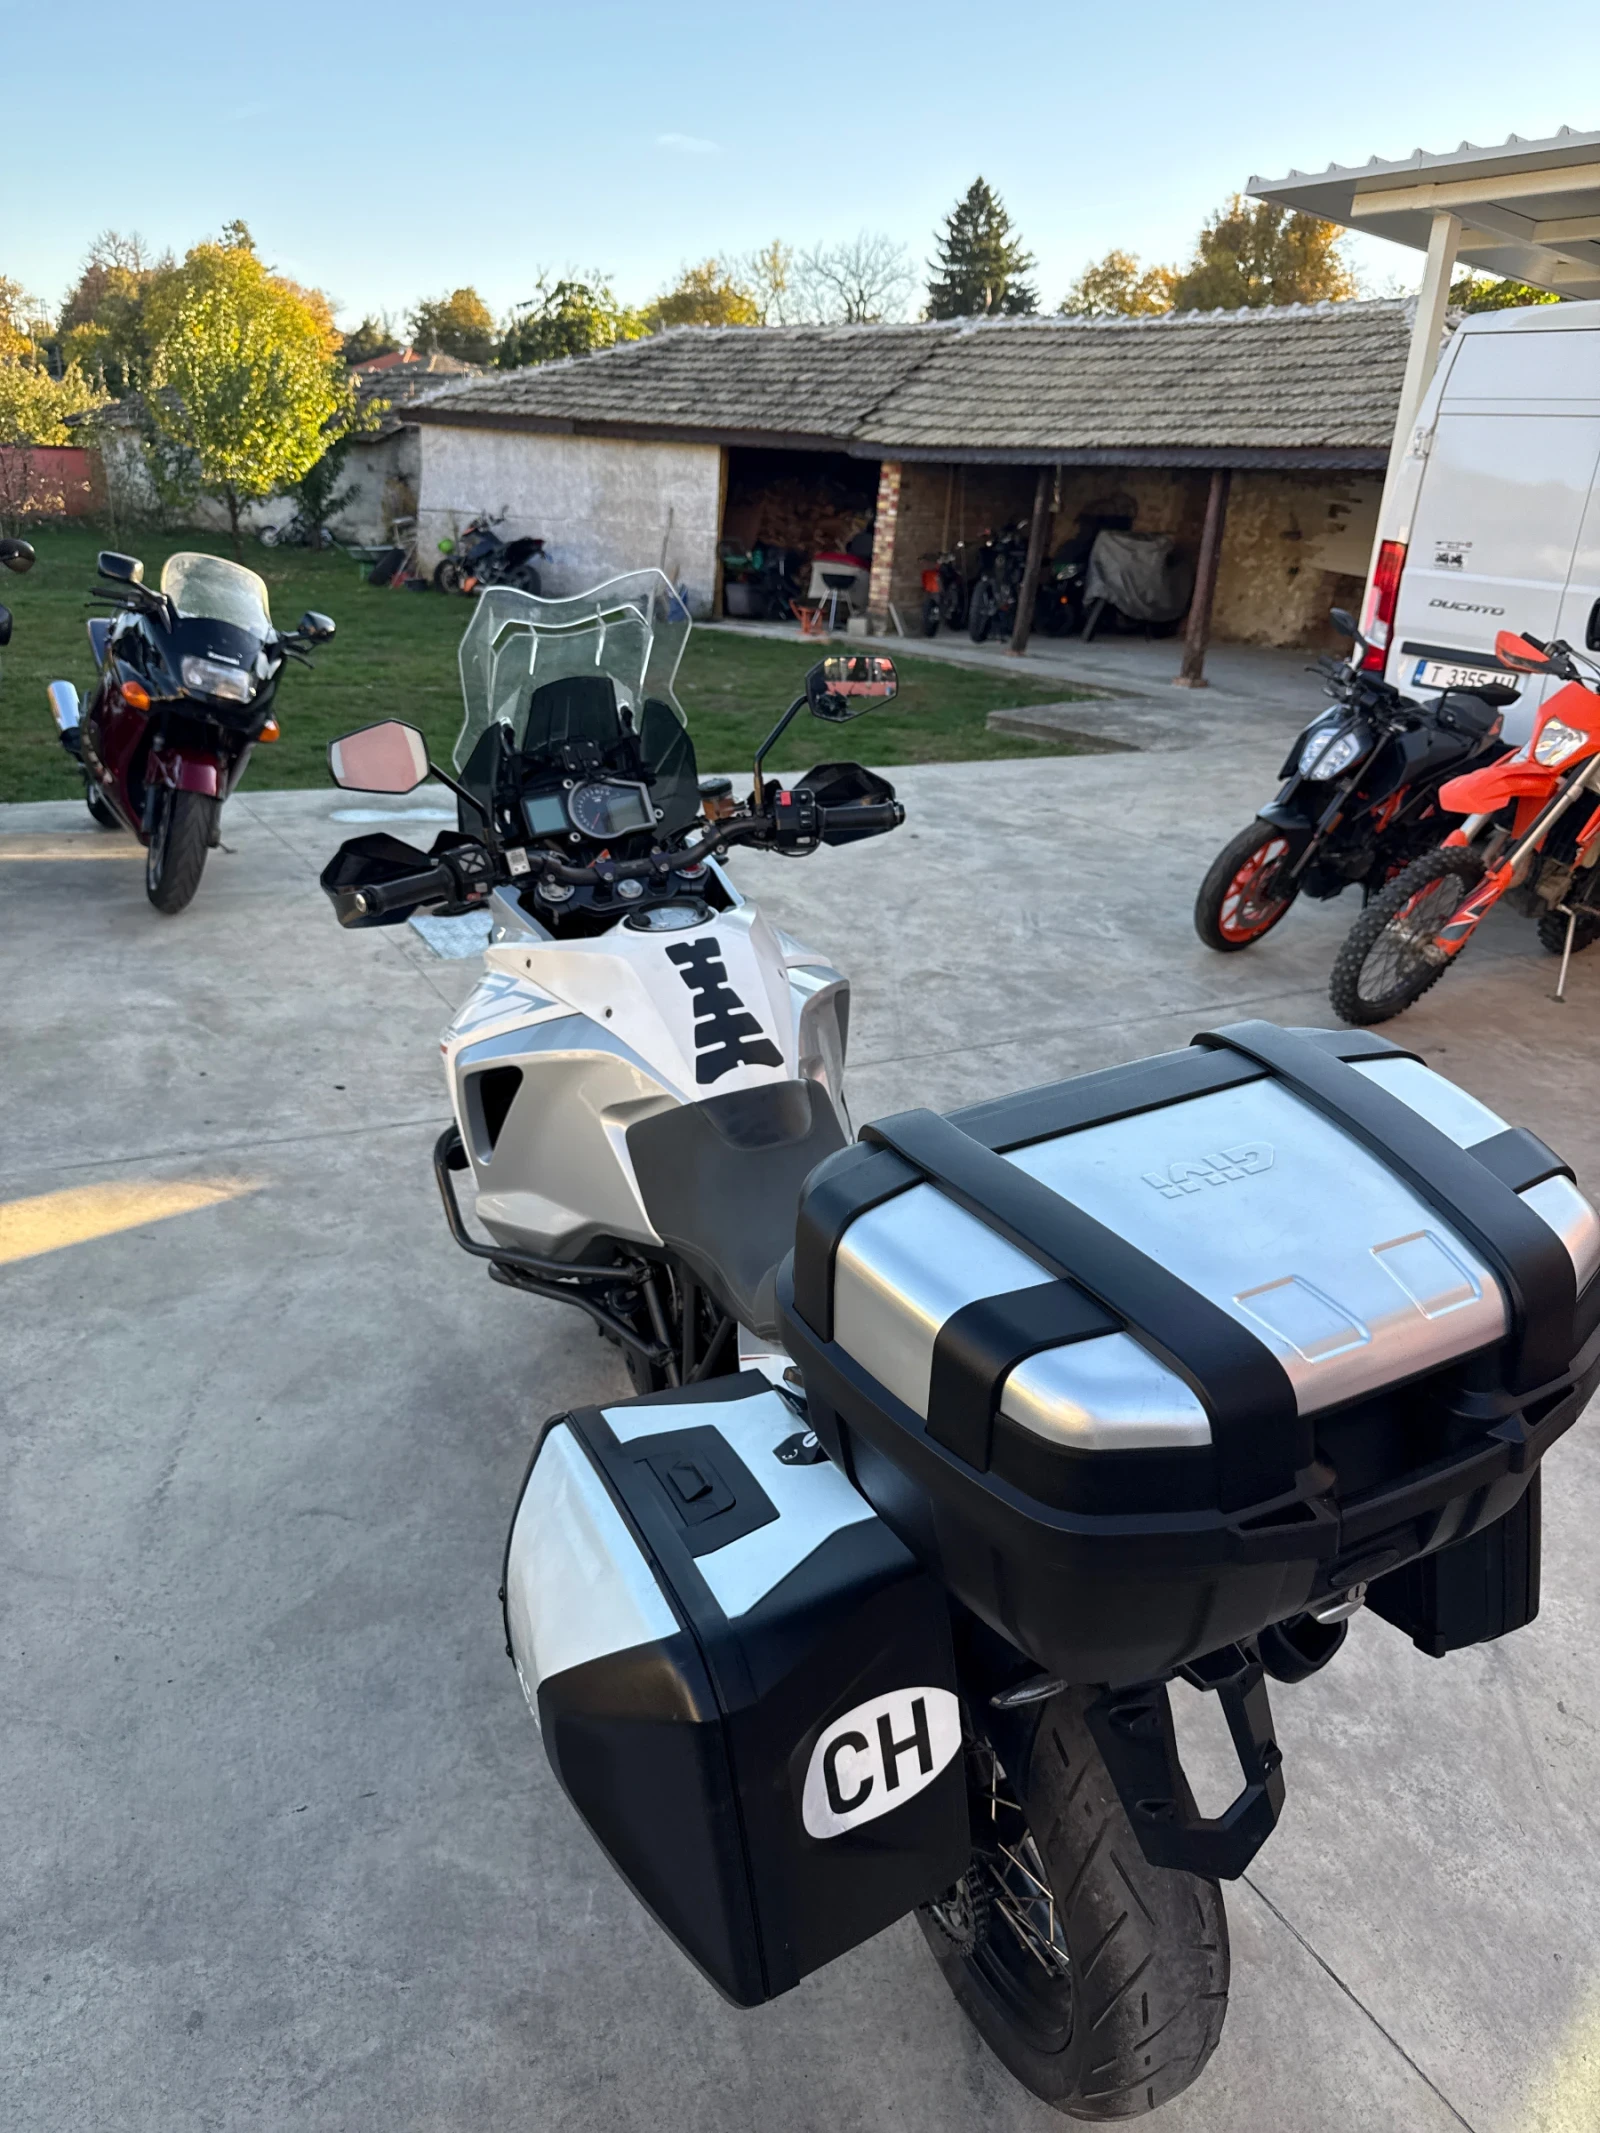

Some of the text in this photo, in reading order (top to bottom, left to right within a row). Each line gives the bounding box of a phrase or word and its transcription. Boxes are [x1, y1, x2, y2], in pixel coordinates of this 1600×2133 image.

[1428, 598, 1505, 616] DUCATO
[1431, 665, 1443, 683] T
[1446, 669, 1487, 688] 3355
[1140, 1141, 1274, 1199] GIVI
[823, 1696, 934, 1815] CH
